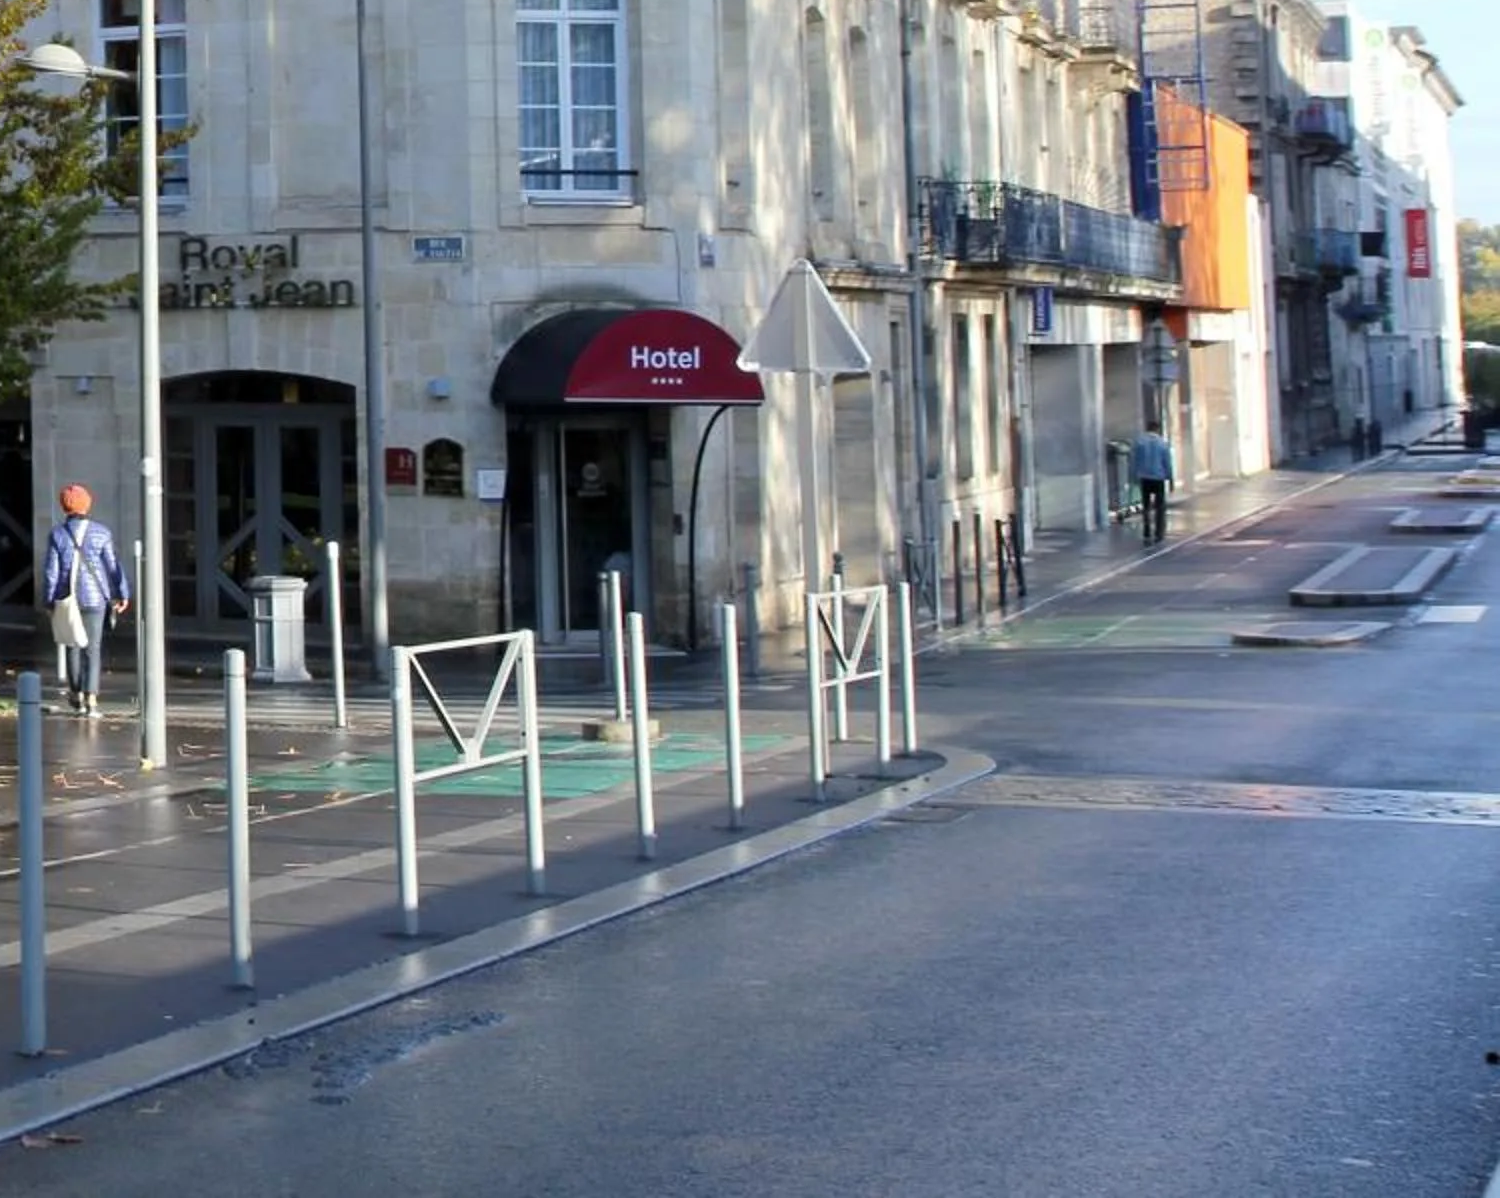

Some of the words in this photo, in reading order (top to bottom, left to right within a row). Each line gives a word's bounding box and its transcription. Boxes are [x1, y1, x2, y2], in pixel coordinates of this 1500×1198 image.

[179, 235, 300, 279] Royal
[129, 275, 235, 309] aint
[249, 275, 356, 309] Jean
[630, 345, 702, 370] Hotel
